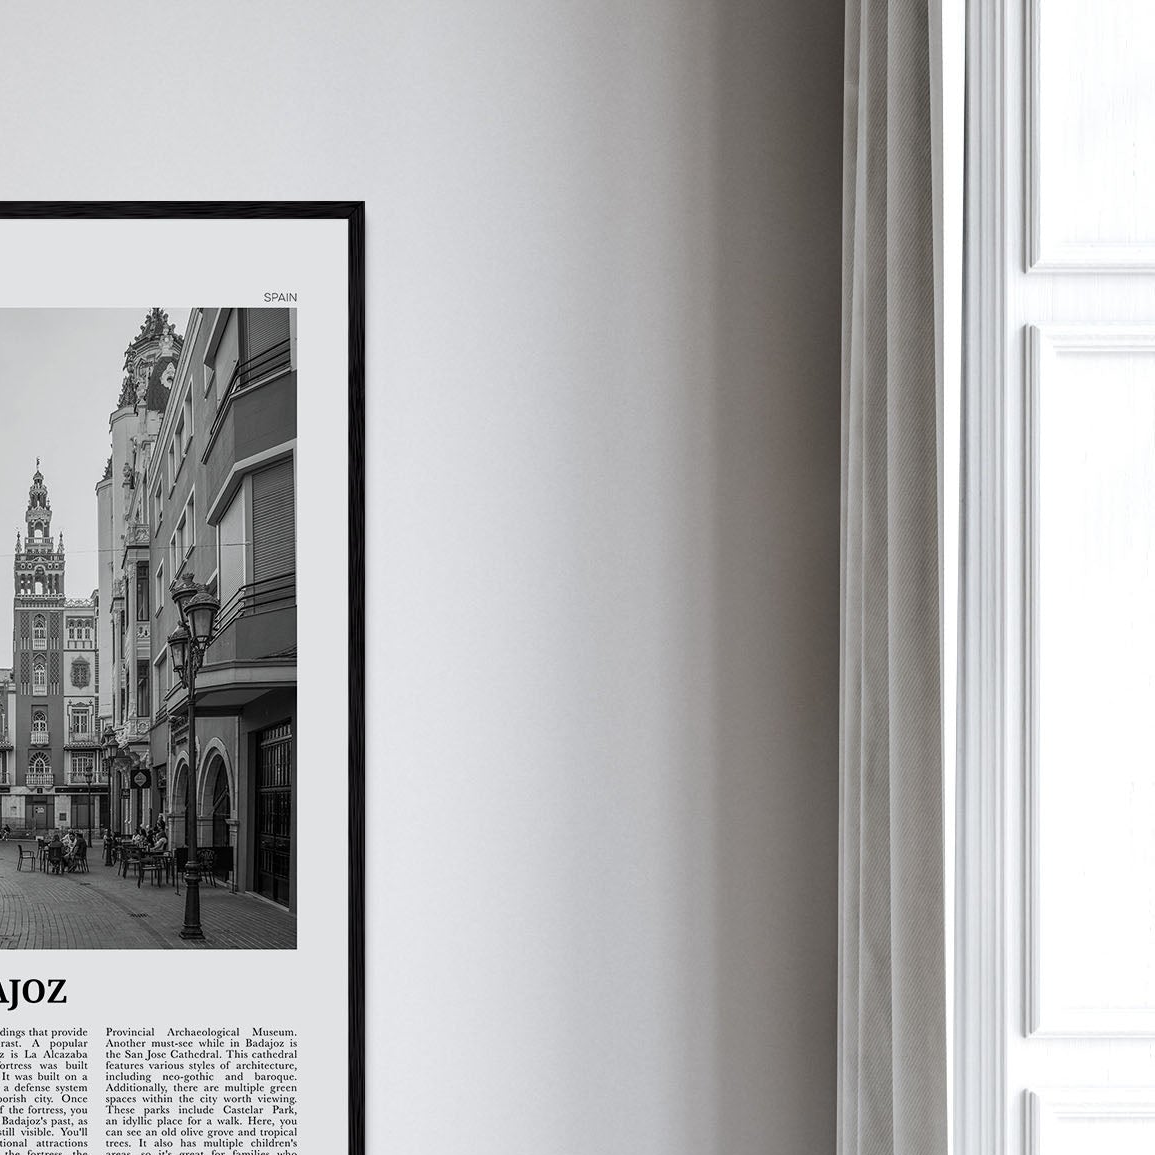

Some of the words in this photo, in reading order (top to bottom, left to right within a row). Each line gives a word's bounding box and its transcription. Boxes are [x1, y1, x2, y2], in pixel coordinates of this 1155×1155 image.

[263, 292, 298, 303] SPAIN
[28, 1028, 49, 1036] that
[51, 1028, 88, 1039] provide
[106, 1028, 155, 1036] Provincial
[166, 1028, 240, 1039] Archaeological
[252, 1028, 297, 1036] Museum.
[31, 1039, 41, 1048] A
[49, 1039, 89, 1050] popular
[105, 1039, 147, 1048] Another
[151, 1039, 194, 1048] must-see
[198, 1039, 225, 1048] while
[230, 1039, 240, 1048] in
[245, 1039, 285, 1050] Badajoz
[289, 1039, 298, 1048] is
[10, 1050, 19, 1059] is
[24, 1050, 38, 1059] La
[42, 1050, 88, 1059] Alcazaba
[105, 1050, 122, 1059] the
[124, 1050, 144, 1059] San
[145, 1050, 167, 1061] Jose
[170, 1050, 222, 1059] Cathedral.
[225, 1050, 249, 1059] This
[251, 1050, 298, 1059] cathedral
[65, 1061, 89, 1070] built
[105, 1061, 145, 1070] features
[148, 1061, 185, 1070] various
[188, 1061, 216, 1072] styles
[219, 1061, 232, 1070] of
[235, 1061, 298, 1072] architecture,
[105, 1072, 152, 1083] including
[162, 1072, 214, 1083] neo-gothic
[224, 1072, 244, 1081] and
[254, 1072, 298, 1083] baroque.
[105, 1083, 168, 1094] Additionally,
[173, 1083, 199, 1092] there
[224, 1083, 265, 1094] multiple
[269, 1086, 298, 1094] green
[34, 1094, 54, 1106] city.
[61, 1094, 88, 1103] Once
[105, 1097, 137, 1106] spaces
[142, 1094, 173, 1103] within
[178, 1094, 195, 1103] the
[199, 1094, 218, 1106] city
[223, 1094, 252, 1103] worth
[257, 1094, 297, 1106] viewing.
[105, 1106, 136, 1114] These
[143, 1106, 171, 1117] parks
[178, 1106, 215, 1114] include
[222, 1106, 264, 1114] Castelar
[272, 1106, 298, 1117] Park,
[35, 1139, 89, 1147] attractions
[105, 1139, 132, 1147] trees.
[138, 1139, 147, 1147] It
[153, 1139, 174, 1147] also
[180, 1139, 197, 1147] has
[203, 1139, 244, 1150] multiple
[250, 1139, 298, 1147] children's
